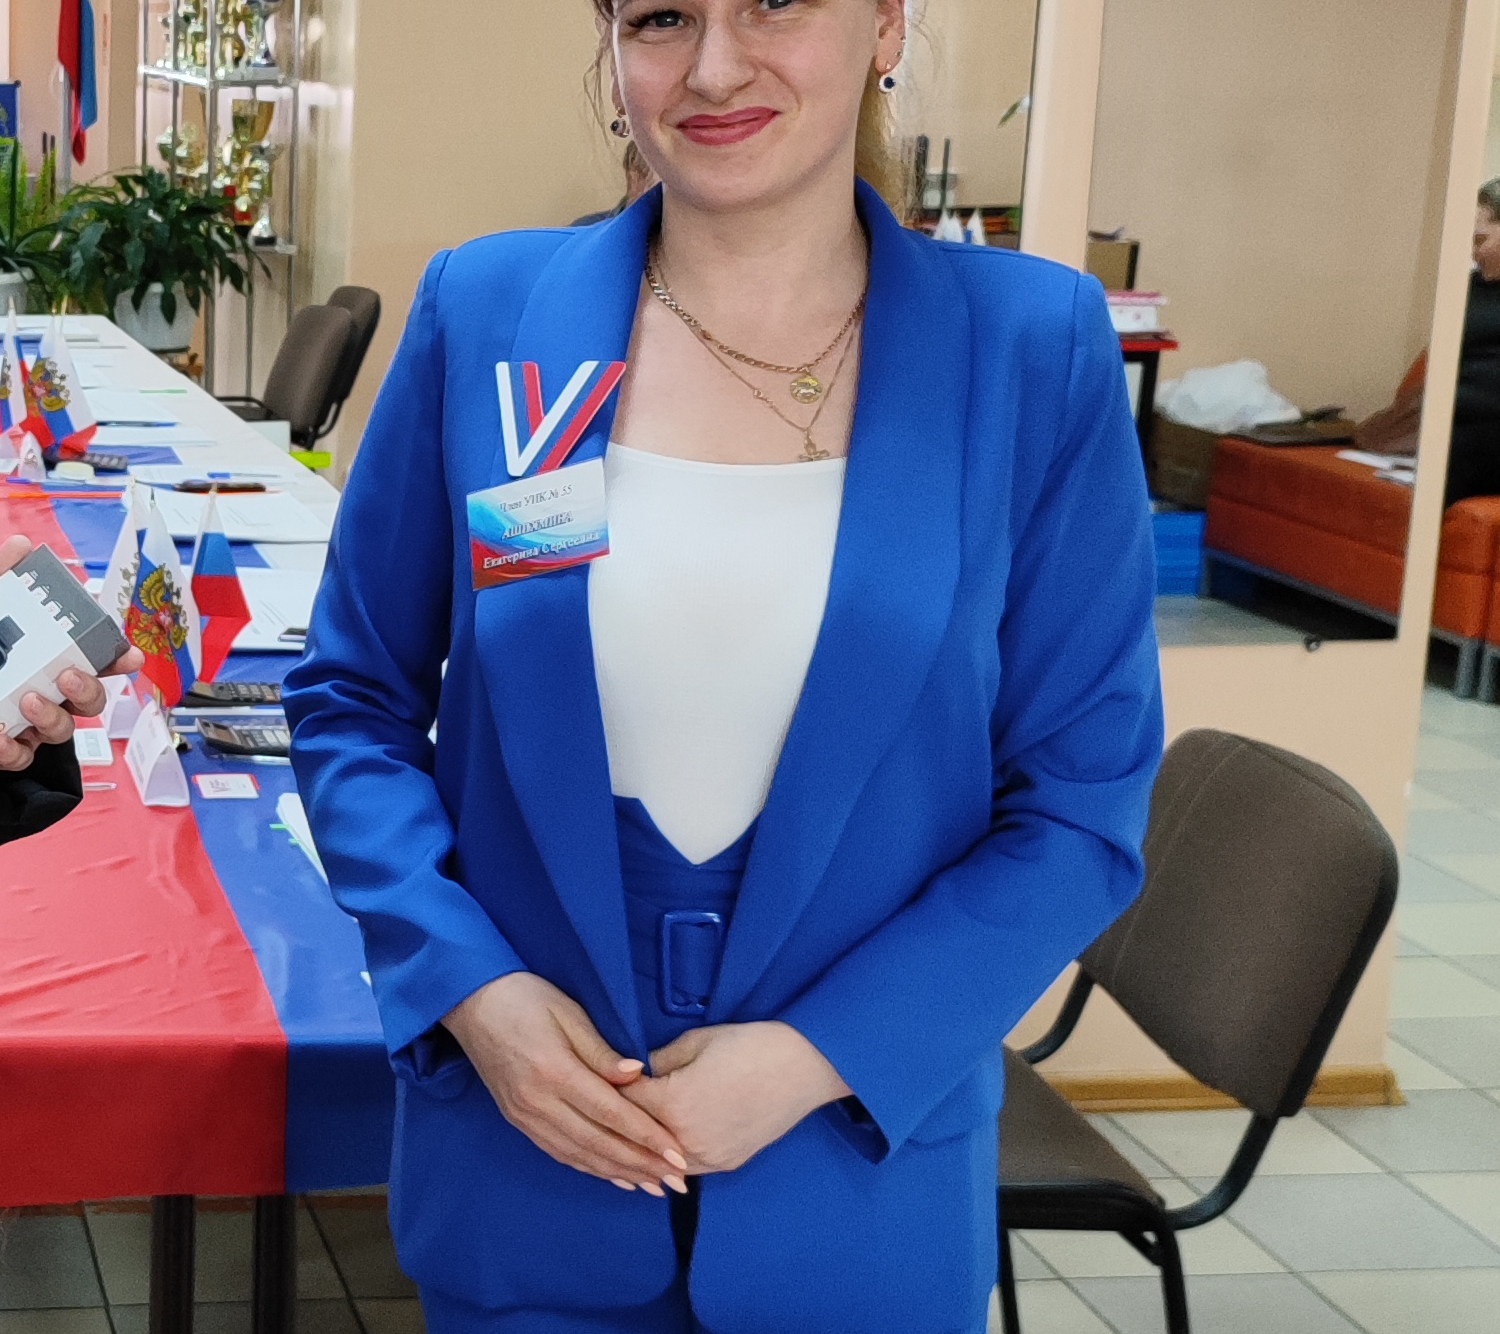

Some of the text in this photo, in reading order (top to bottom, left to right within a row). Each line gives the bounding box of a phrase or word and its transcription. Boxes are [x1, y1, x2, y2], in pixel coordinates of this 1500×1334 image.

[500, 500, 522, 512] Член
[524, 491, 547, 506] УИК
[560, 484, 573, 497] 55
[483, 531, 600, 569] Екатерина Сергеевна
